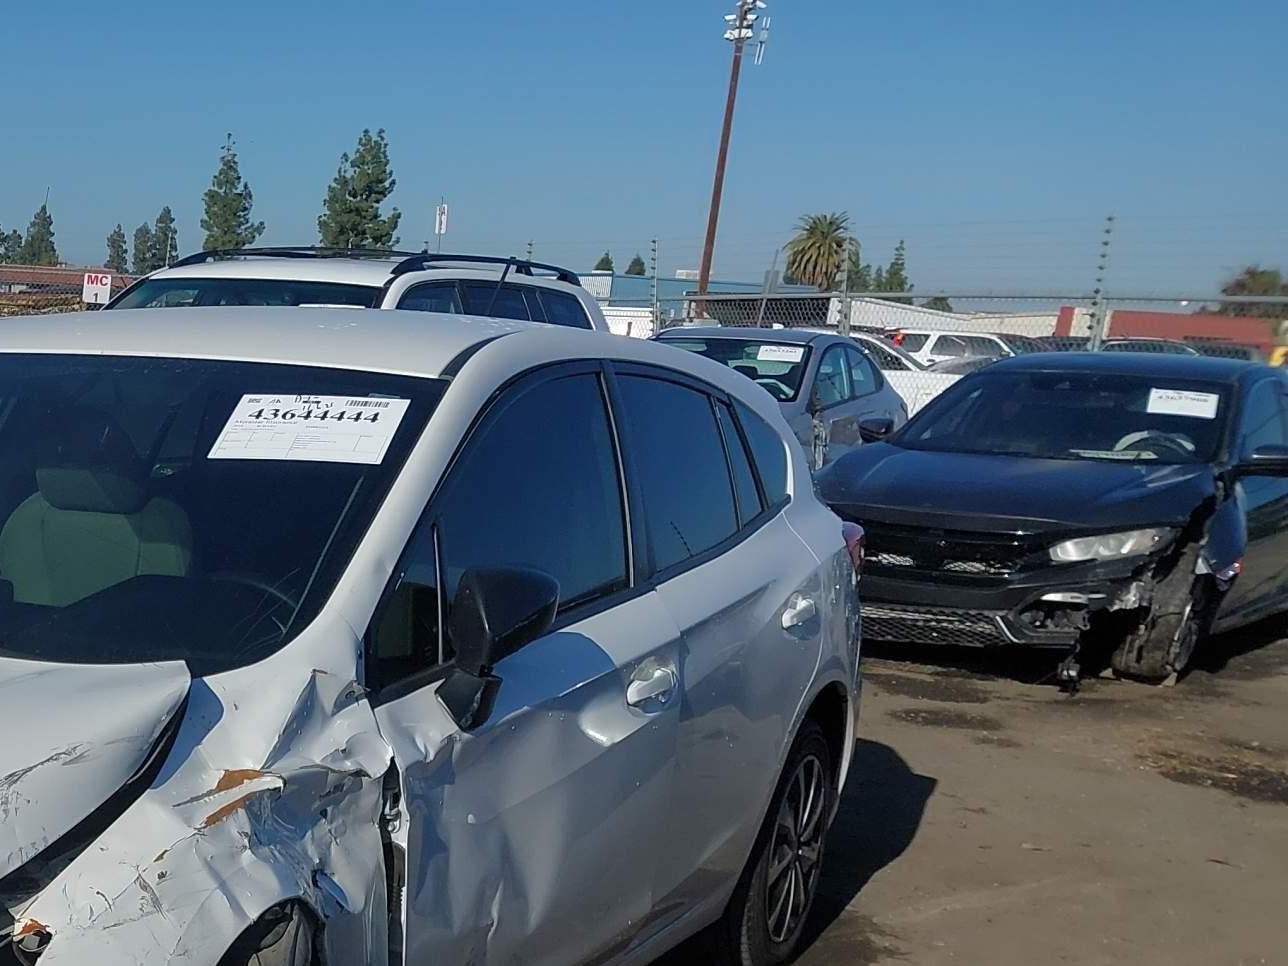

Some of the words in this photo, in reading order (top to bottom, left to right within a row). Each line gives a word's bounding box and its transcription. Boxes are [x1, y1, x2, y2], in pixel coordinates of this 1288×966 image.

[87, 274, 109, 287] MC
[93, 292, 99, 303] 1
[247, 408, 380, 423] 43644444
